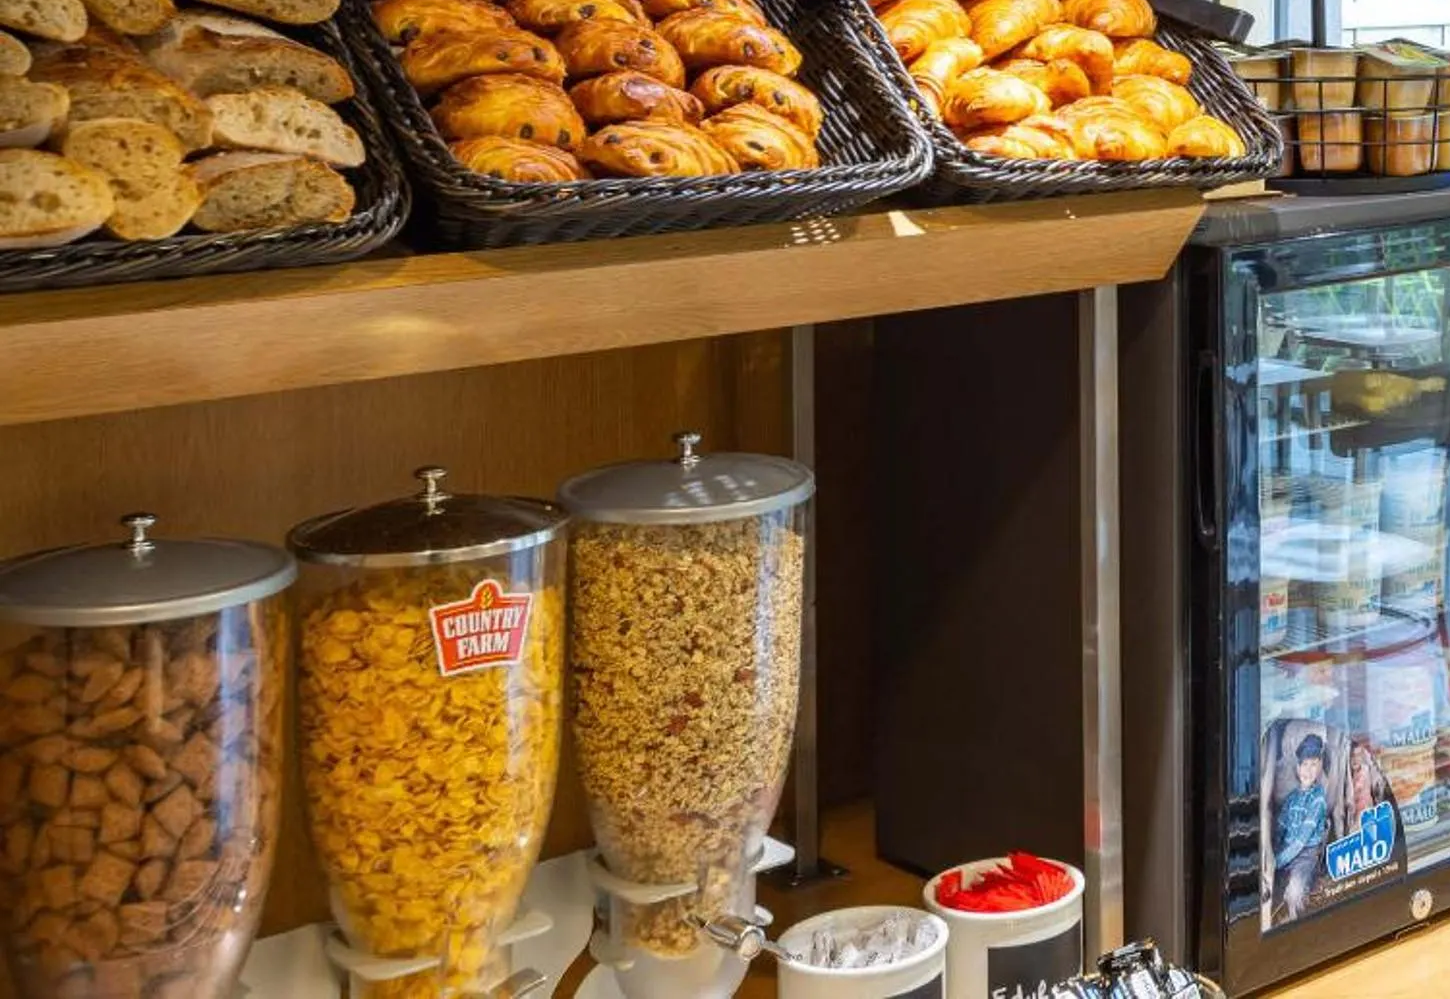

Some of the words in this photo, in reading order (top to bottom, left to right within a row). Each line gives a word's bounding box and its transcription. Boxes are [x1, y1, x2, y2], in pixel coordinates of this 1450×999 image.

[442, 605, 525, 640] COUNTRY
[457, 631, 512, 660] FARM
[1335, 840, 1389, 877] MALO
